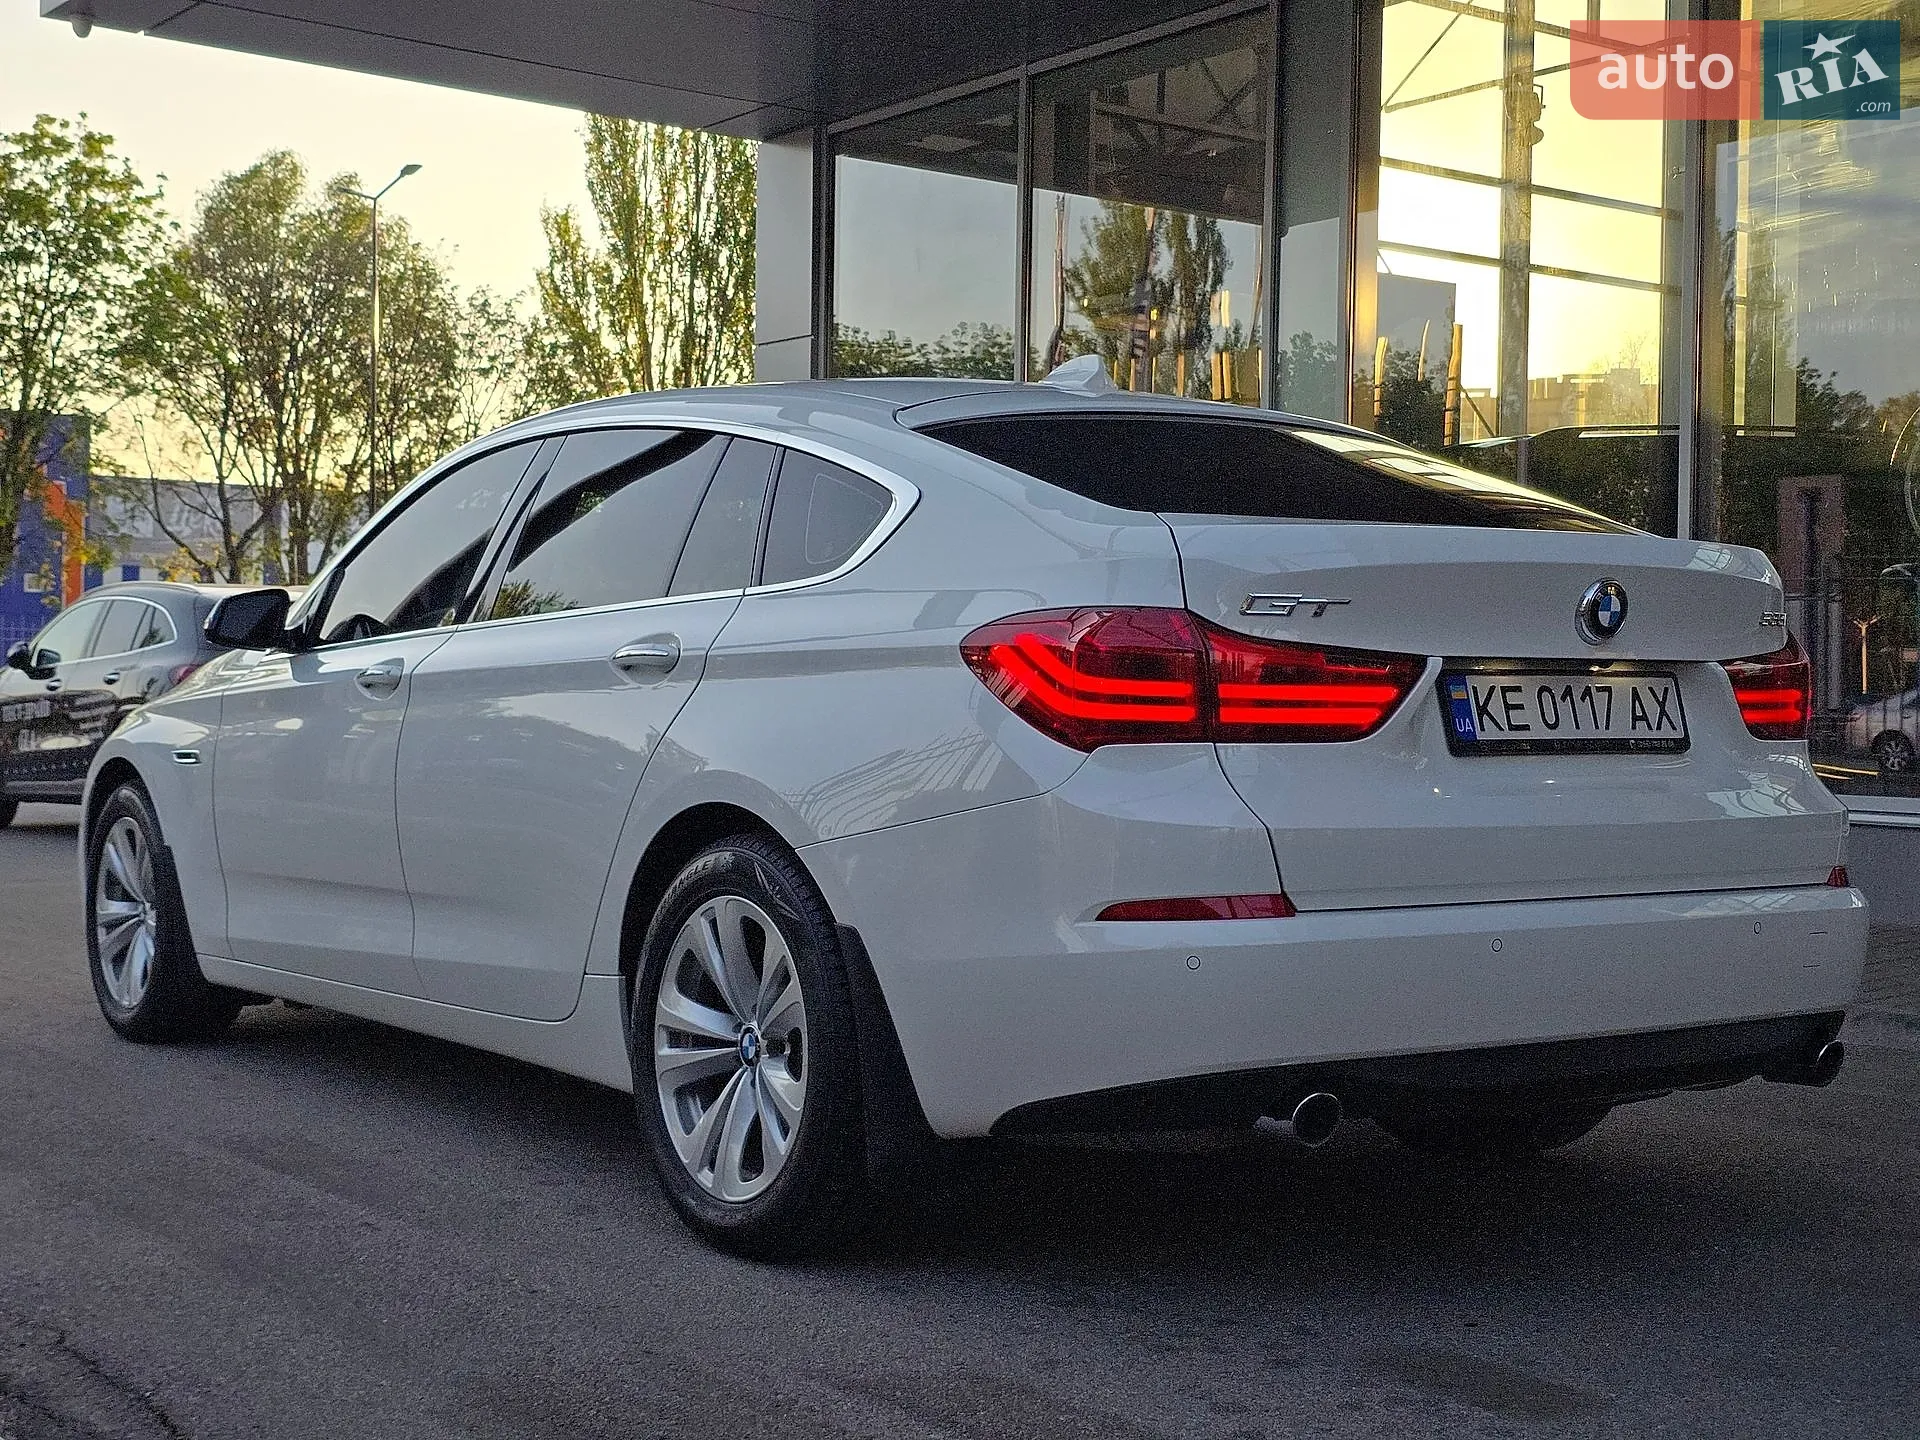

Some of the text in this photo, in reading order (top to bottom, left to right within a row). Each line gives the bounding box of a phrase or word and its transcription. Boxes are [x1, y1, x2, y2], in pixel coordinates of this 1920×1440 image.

[1239, 593, 1352, 617] GT
[1471, 685, 1678, 731] KE 0117 AX
[1455, 719, 1474, 733] UA
